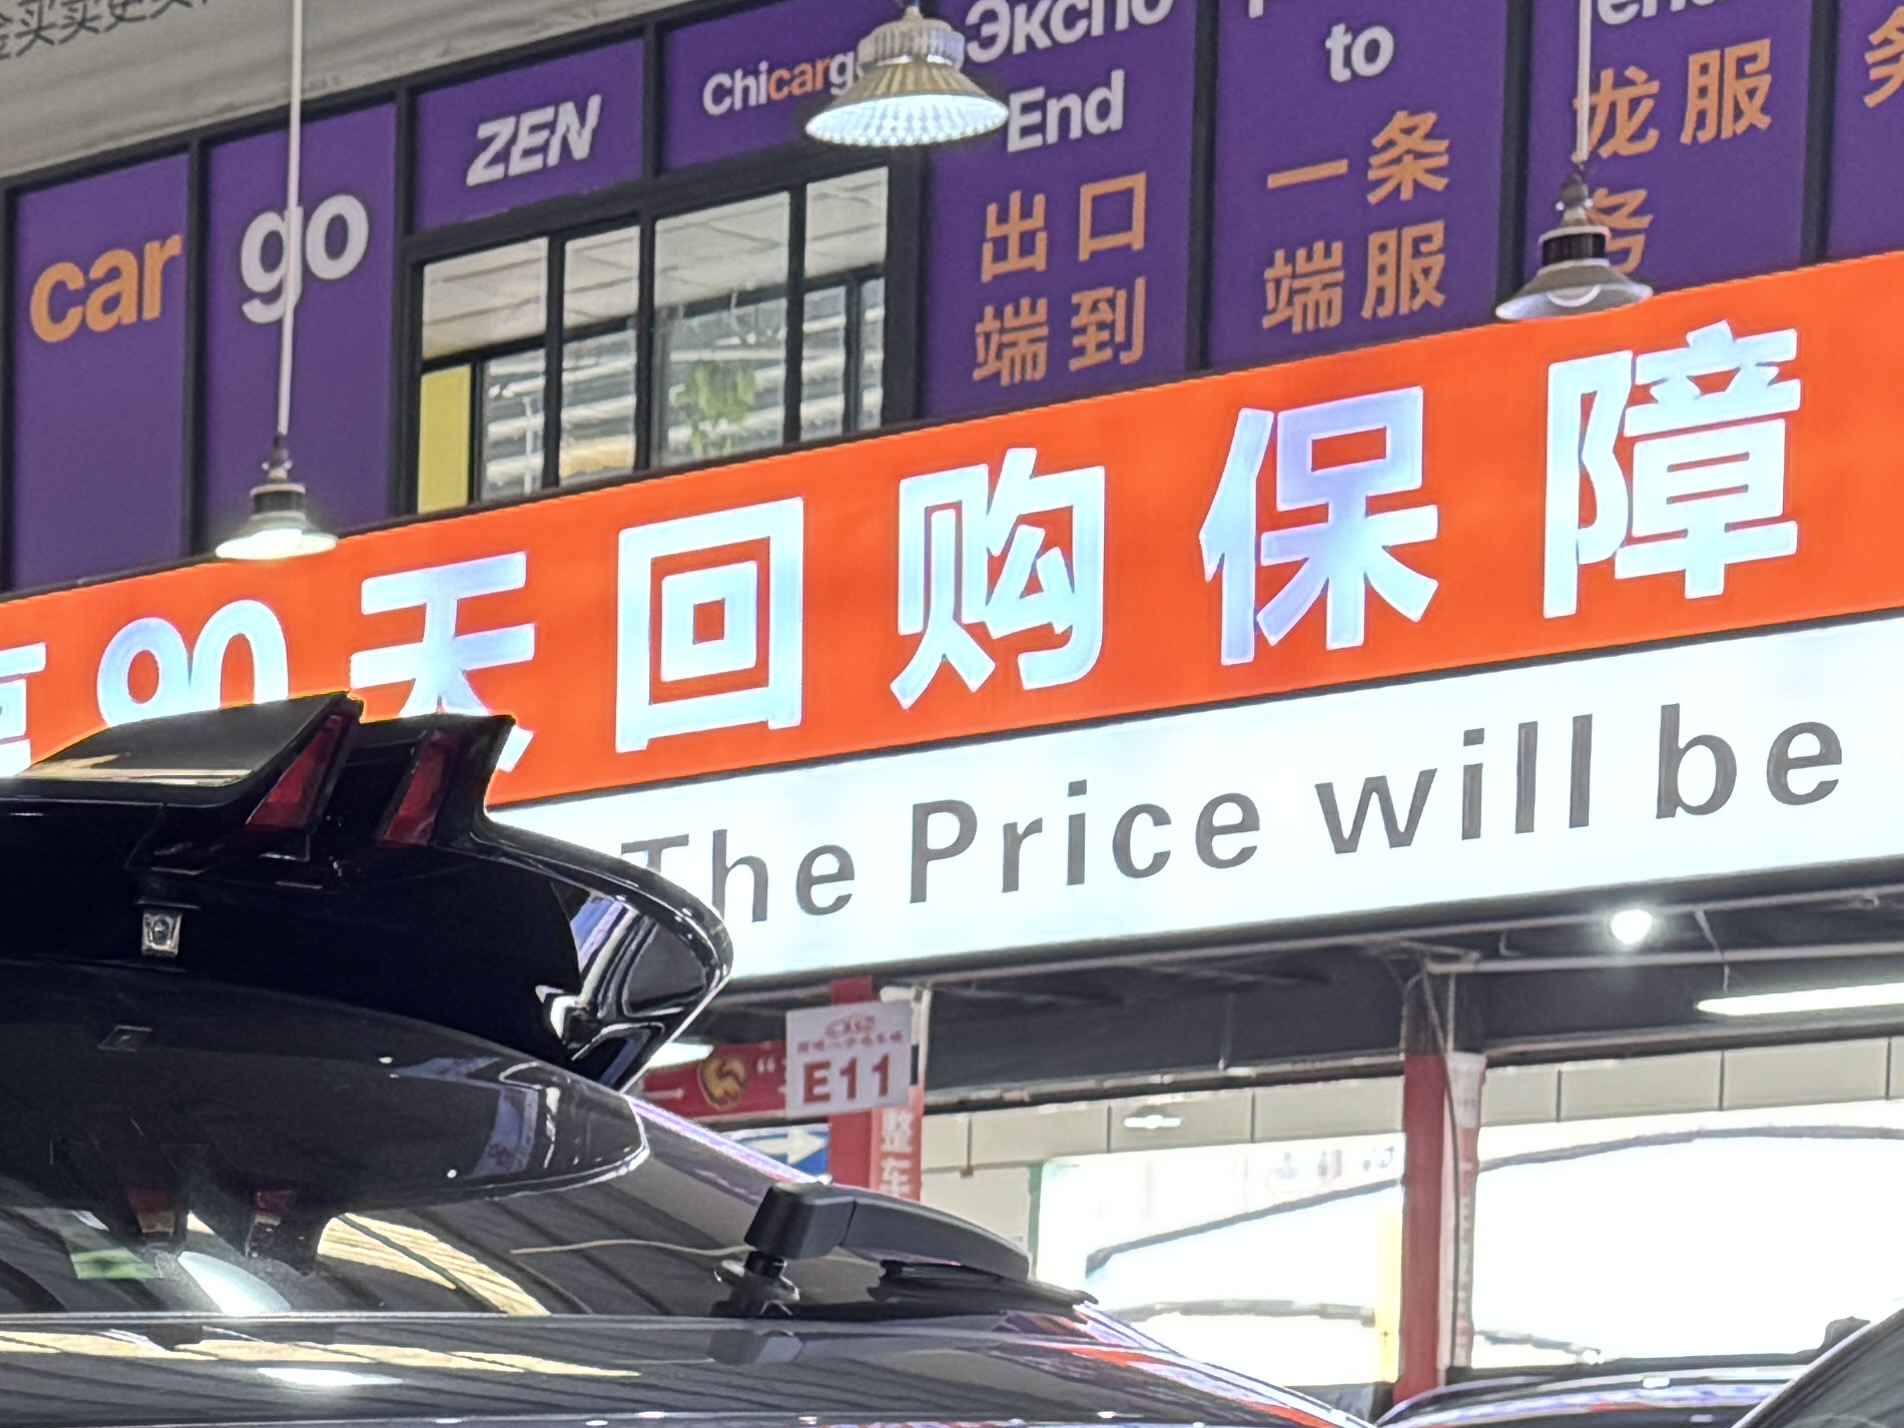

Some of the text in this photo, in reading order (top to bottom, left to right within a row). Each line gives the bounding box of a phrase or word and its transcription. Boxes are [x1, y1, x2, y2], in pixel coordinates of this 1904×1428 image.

[702, 50, 866, 117] Chicarg
[1325, 24, 1394, 82] to
[466, 95, 602, 187] ZEN
[1007, 69, 1126, 153] End
[1266, 109, 1450, 205] 一条
[980, 171, 1148, 283] 出口
[1262, 219, 1446, 335] 端服
[972, 275, 1148, 387] 端到
[620, 702, 1844, 922] The Price will be
[804, 1052, 892, 1106] E11
